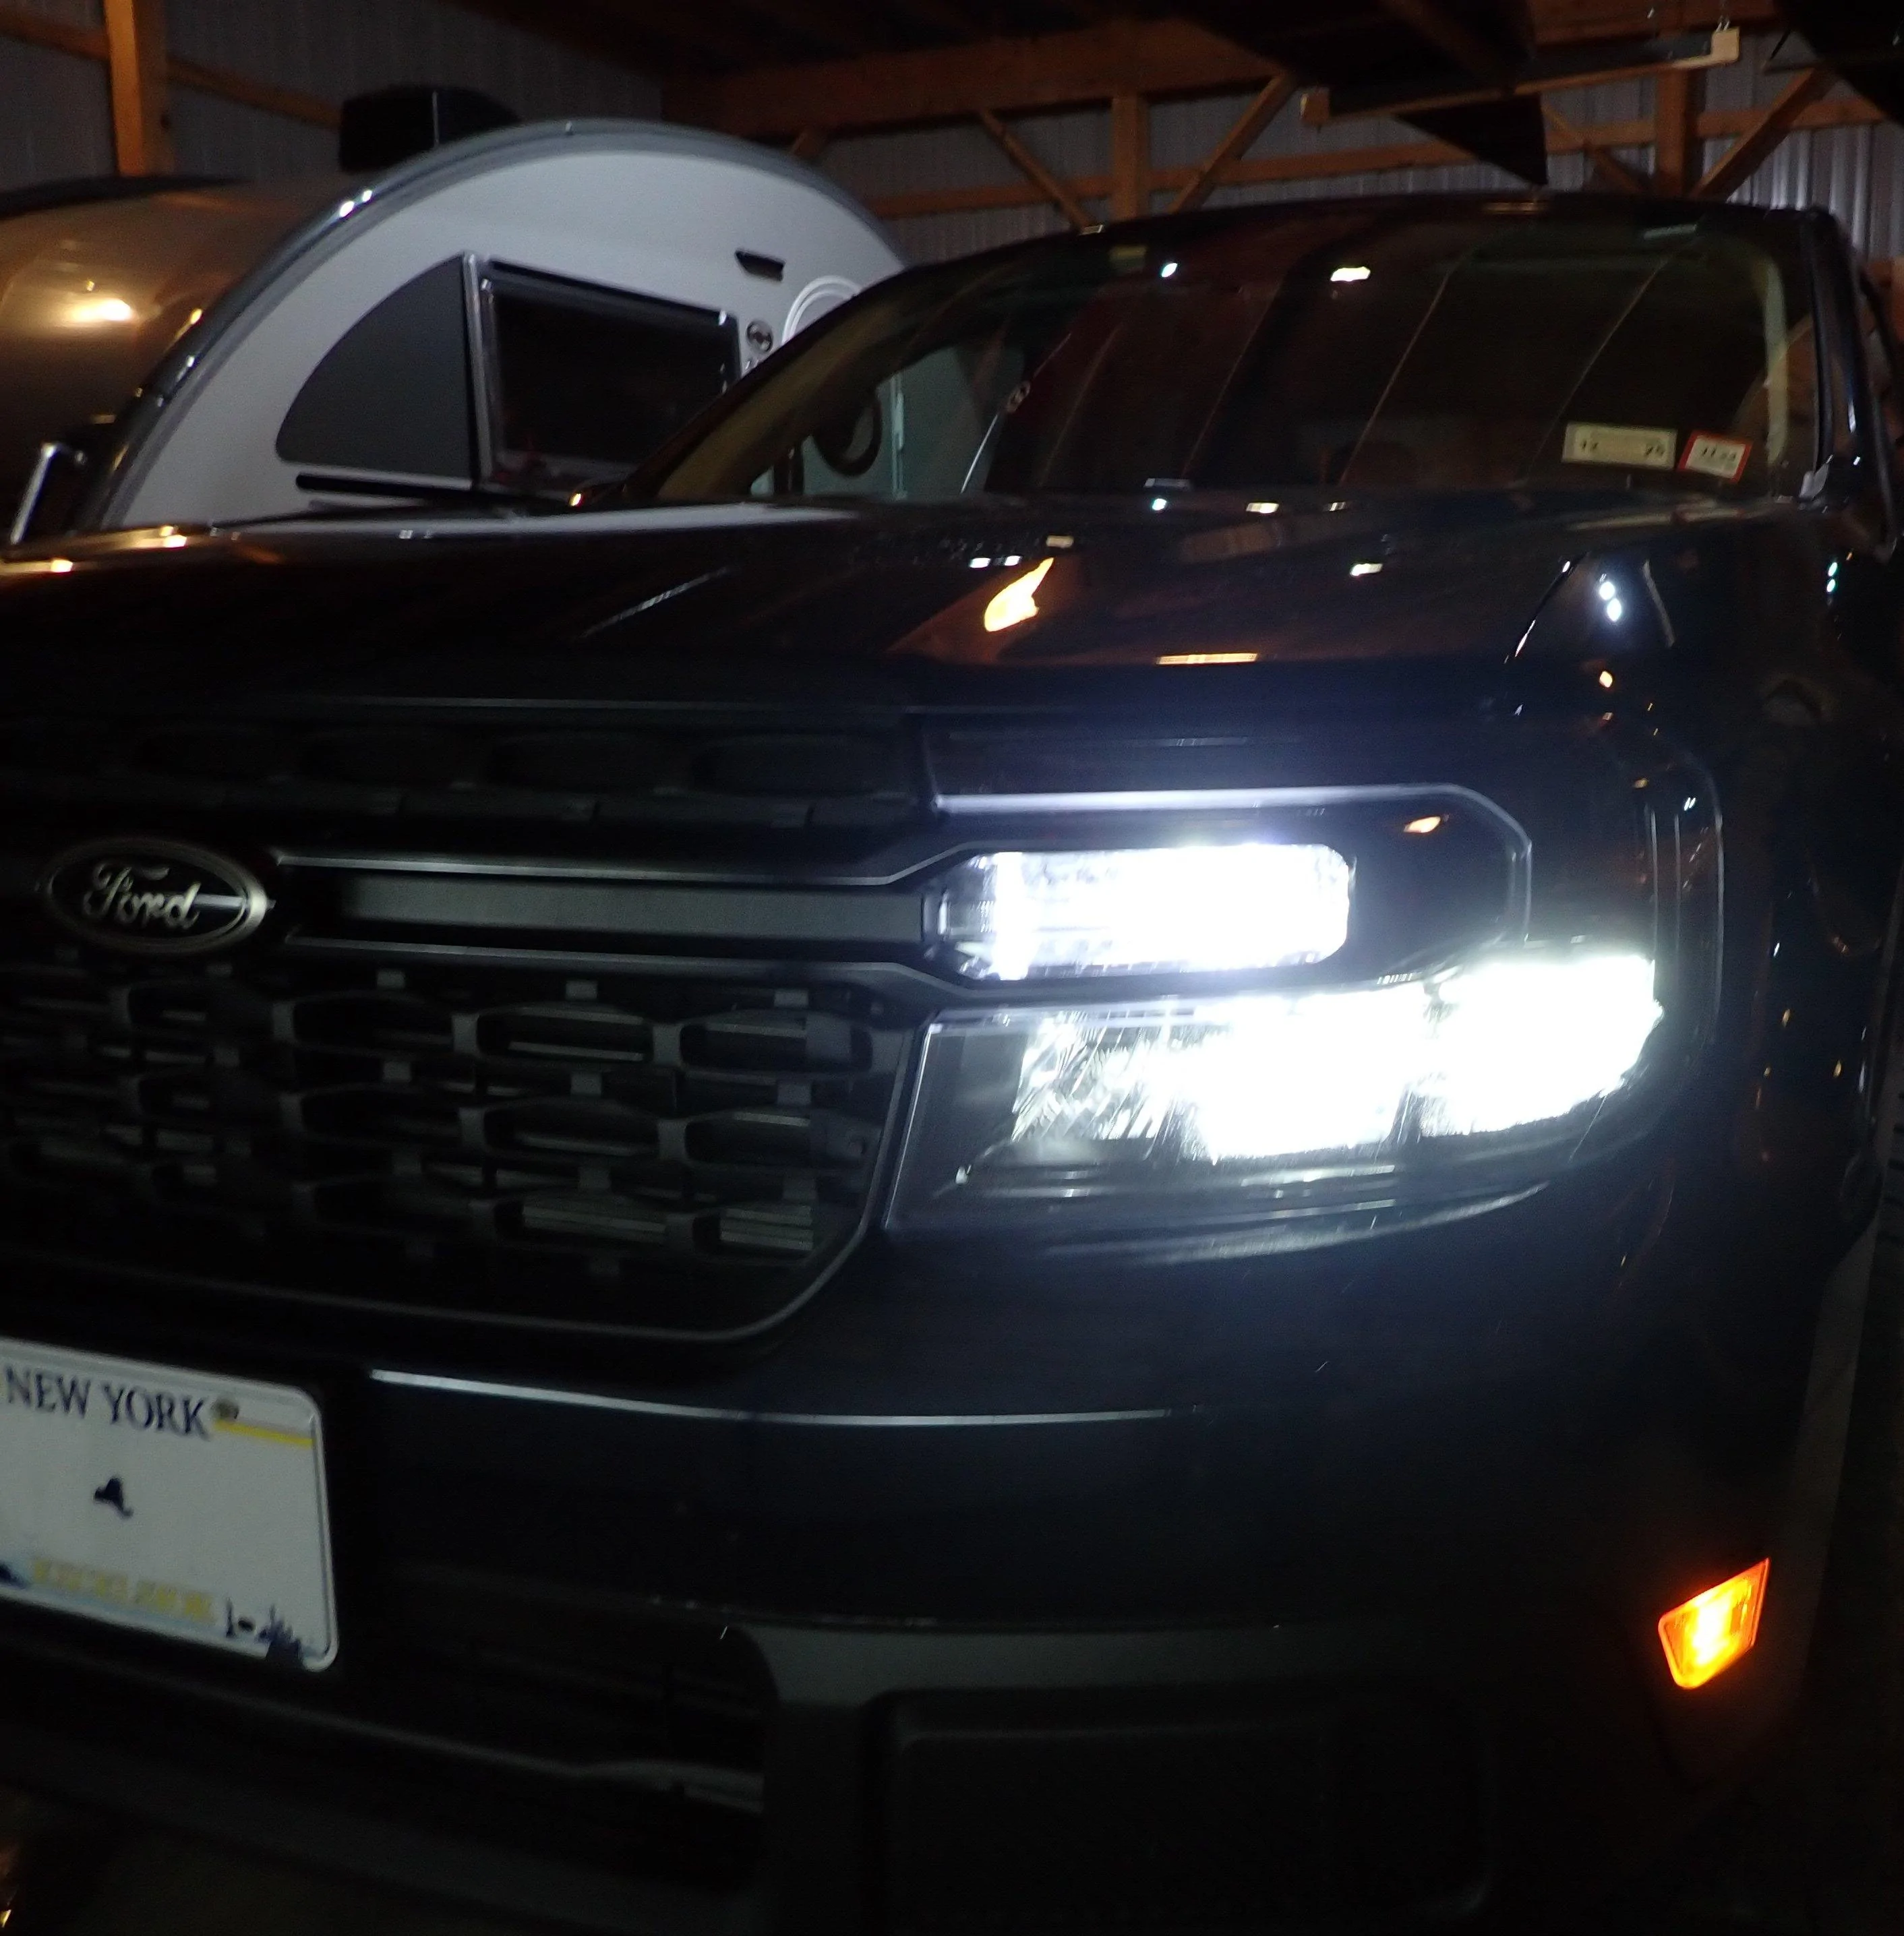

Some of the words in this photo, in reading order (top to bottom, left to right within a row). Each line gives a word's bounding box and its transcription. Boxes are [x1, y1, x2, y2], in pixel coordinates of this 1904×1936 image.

[82, 861, 202, 930] Ford
[5, 1364, 91, 1419] NEW
[100, 1381, 212, 1441] YORK
